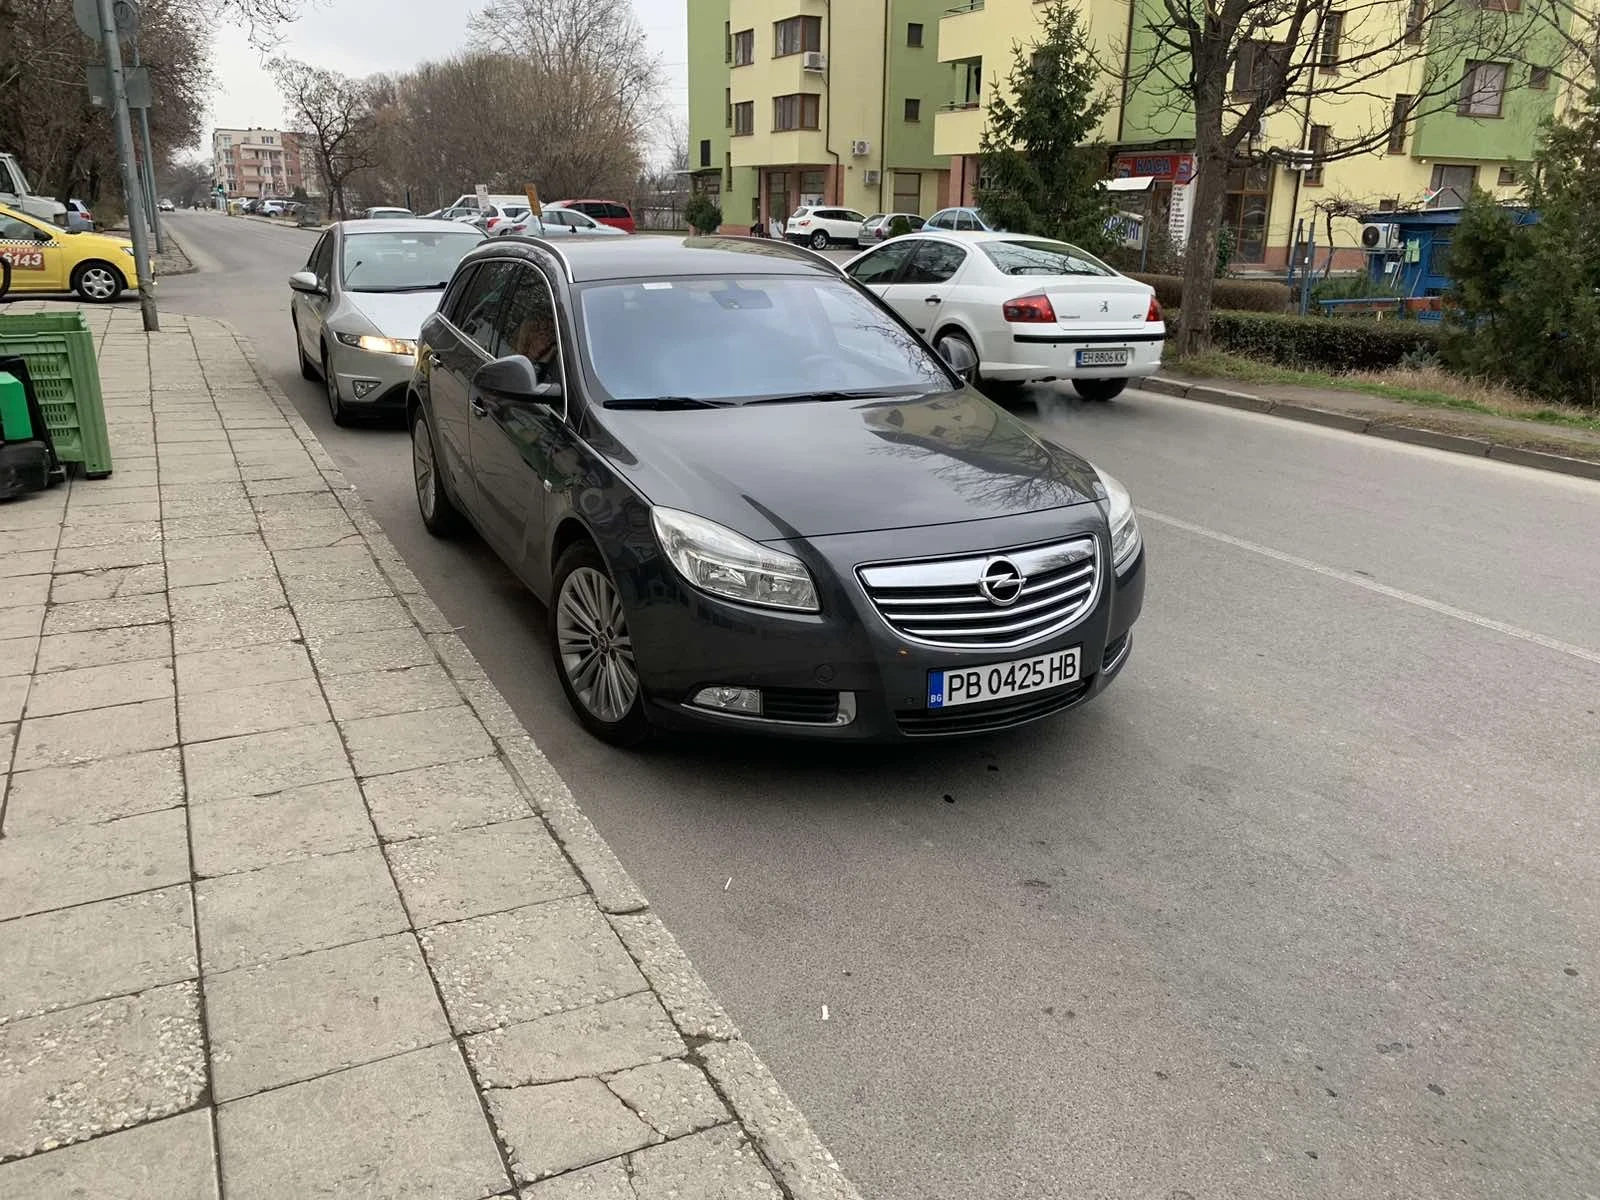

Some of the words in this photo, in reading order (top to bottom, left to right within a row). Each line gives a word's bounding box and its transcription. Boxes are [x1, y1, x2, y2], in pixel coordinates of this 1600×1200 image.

[930, 693, 943, 704] BG
[948, 672, 982, 702] PB
[988, 659, 1045, 696] 0425
[1049, 652, 1077, 684] HB
